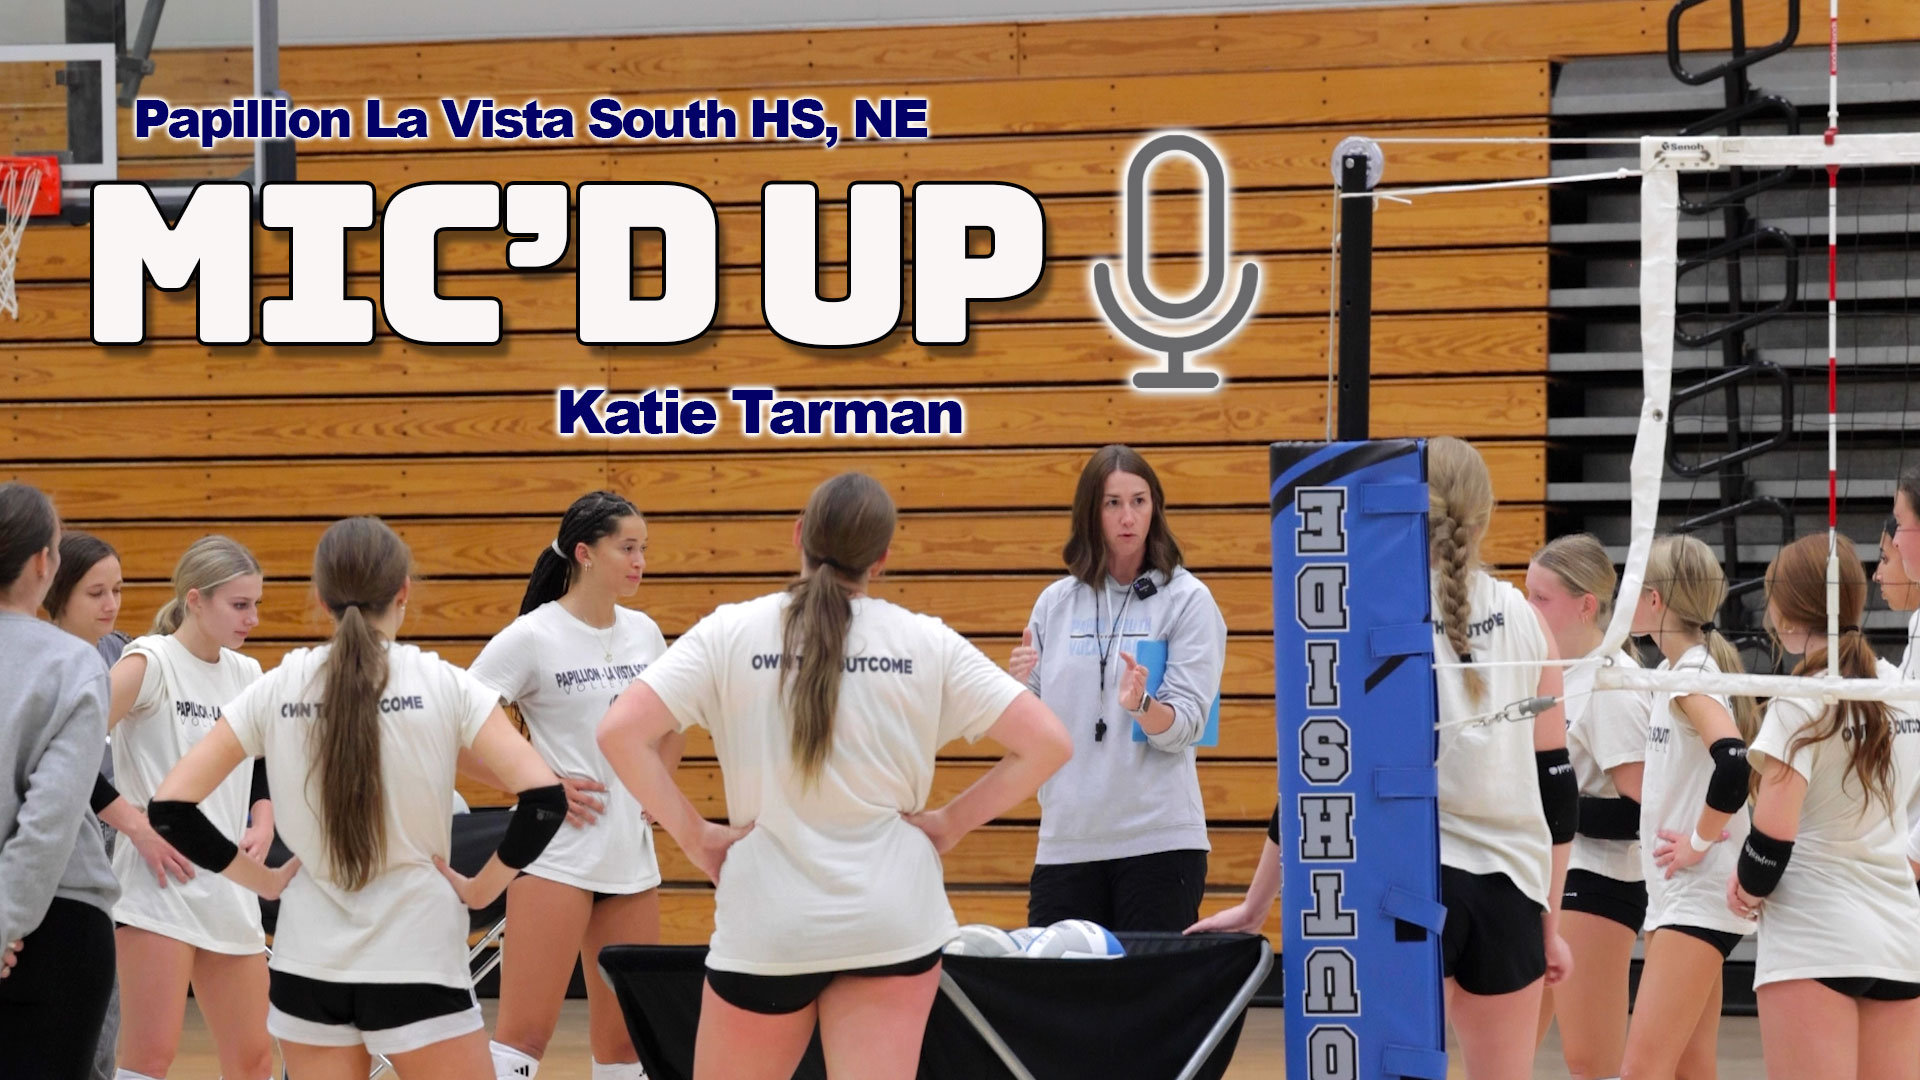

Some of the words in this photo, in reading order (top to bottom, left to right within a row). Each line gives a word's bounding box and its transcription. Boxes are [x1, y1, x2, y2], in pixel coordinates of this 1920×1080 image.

[1671, 142, 1705, 151] Senoh
[555, 667, 602, 689] PAPILLION
[602, 666, 616, 681] LA
[613, 664, 637, 680] VISTA
